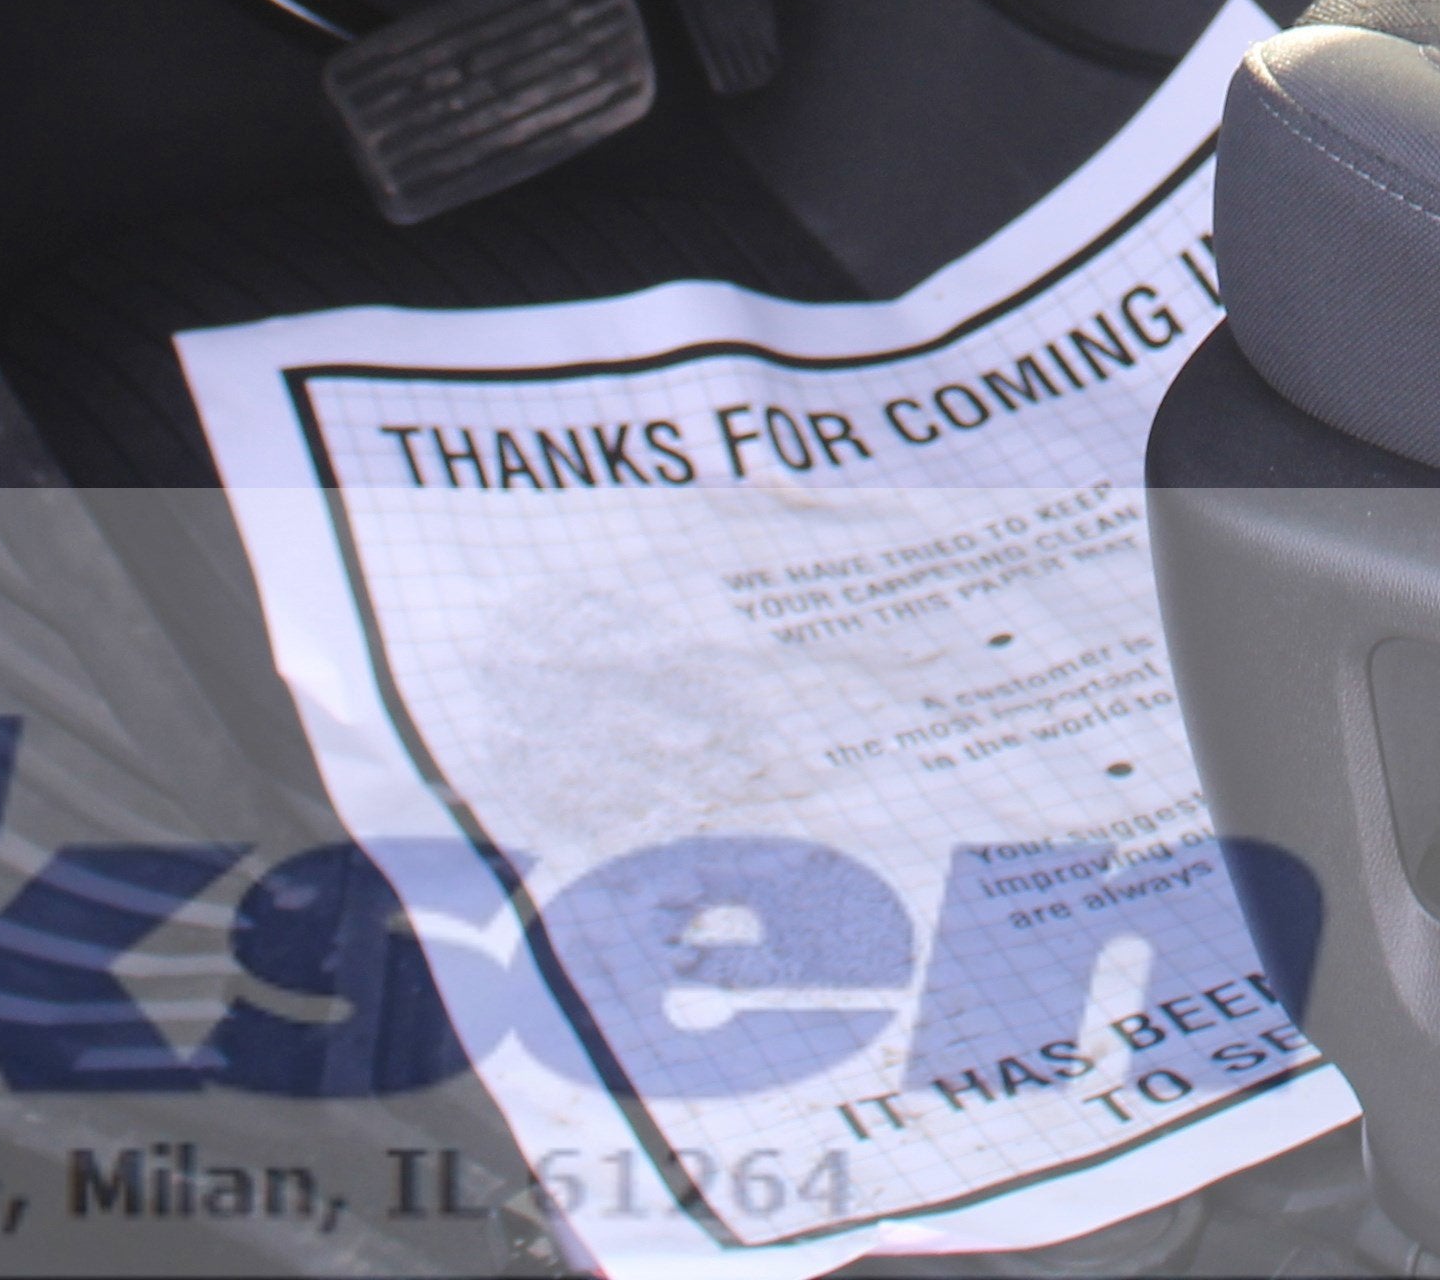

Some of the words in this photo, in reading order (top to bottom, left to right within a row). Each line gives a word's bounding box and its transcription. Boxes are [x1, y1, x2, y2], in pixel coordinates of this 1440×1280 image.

[379, 419, 697, 491] THANKS
[715, 403, 875, 479] FOR
[882, 282, 1186, 446] COMING
[722, 569, 772, 593] WE
[785, 548, 875, 585] HAVE
[880, 535, 978, 567] TRIED
[985, 515, 1030, 541] TO
[1035, 478, 1113, 523] KEEP
[734, 589, 833, 623] YOUR
[842, 544, 1027, 606] CARPETING
[1035, 505, 1141, 551] CLEAN
[770, 612, 861, 646] WITH
[873, 591, 950, 626] THIS
[960, 557, 1066, 602] PAPER
[1071, 535, 1140, 563] MAT
[823, 737, 886, 769] the
[894, 711, 984, 752] most
[989, 660, 1164, 721] important
[954, 644, 1114, 708] customer
[1121, 636, 1155, 657] is
[921, 752, 957, 774] in
[964, 732, 1023, 763] the
[1030, 699, 1132, 743] world
[1135, 688, 1175, 715] to
[967, 835, 1056, 867] Your
[980, 841, 1173, 898] improving
[1007, 901, 1073, 930] are
[1082, 857, 1216, 913] always
[835, 1091, 908, 1143] IT
[929, 1039, 1096, 1113] HAS
[1082, 1068, 1194, 1124] TO
